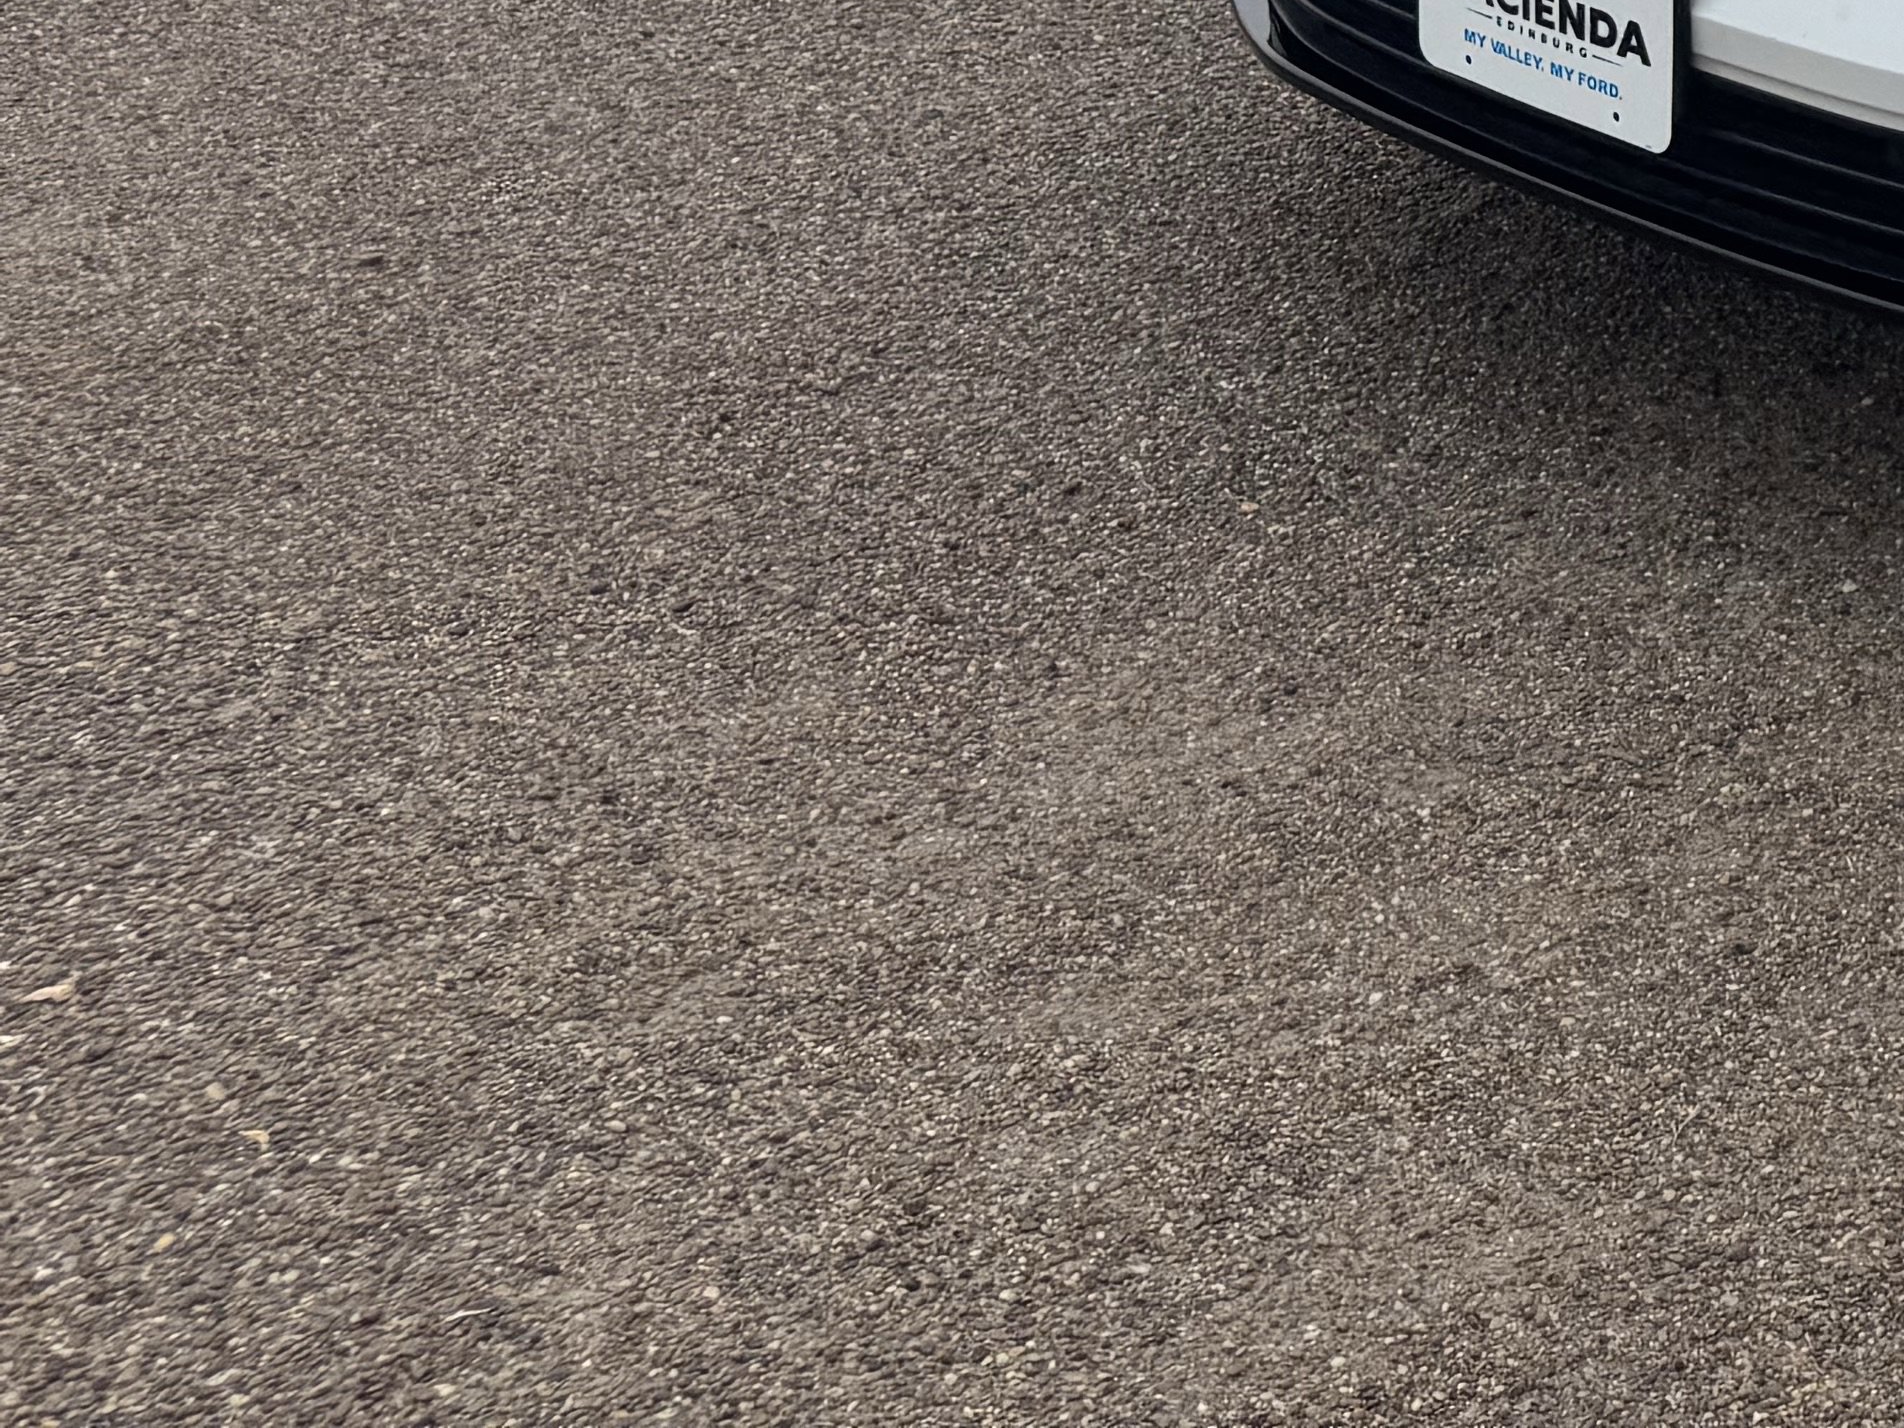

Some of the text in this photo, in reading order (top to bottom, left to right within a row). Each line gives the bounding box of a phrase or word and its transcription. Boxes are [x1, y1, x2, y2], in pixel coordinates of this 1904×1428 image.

[1464, 28, 1623, 101] MY VALLEY. MY FORD.
[1496, 15, 1588, 59] EDINBURG
